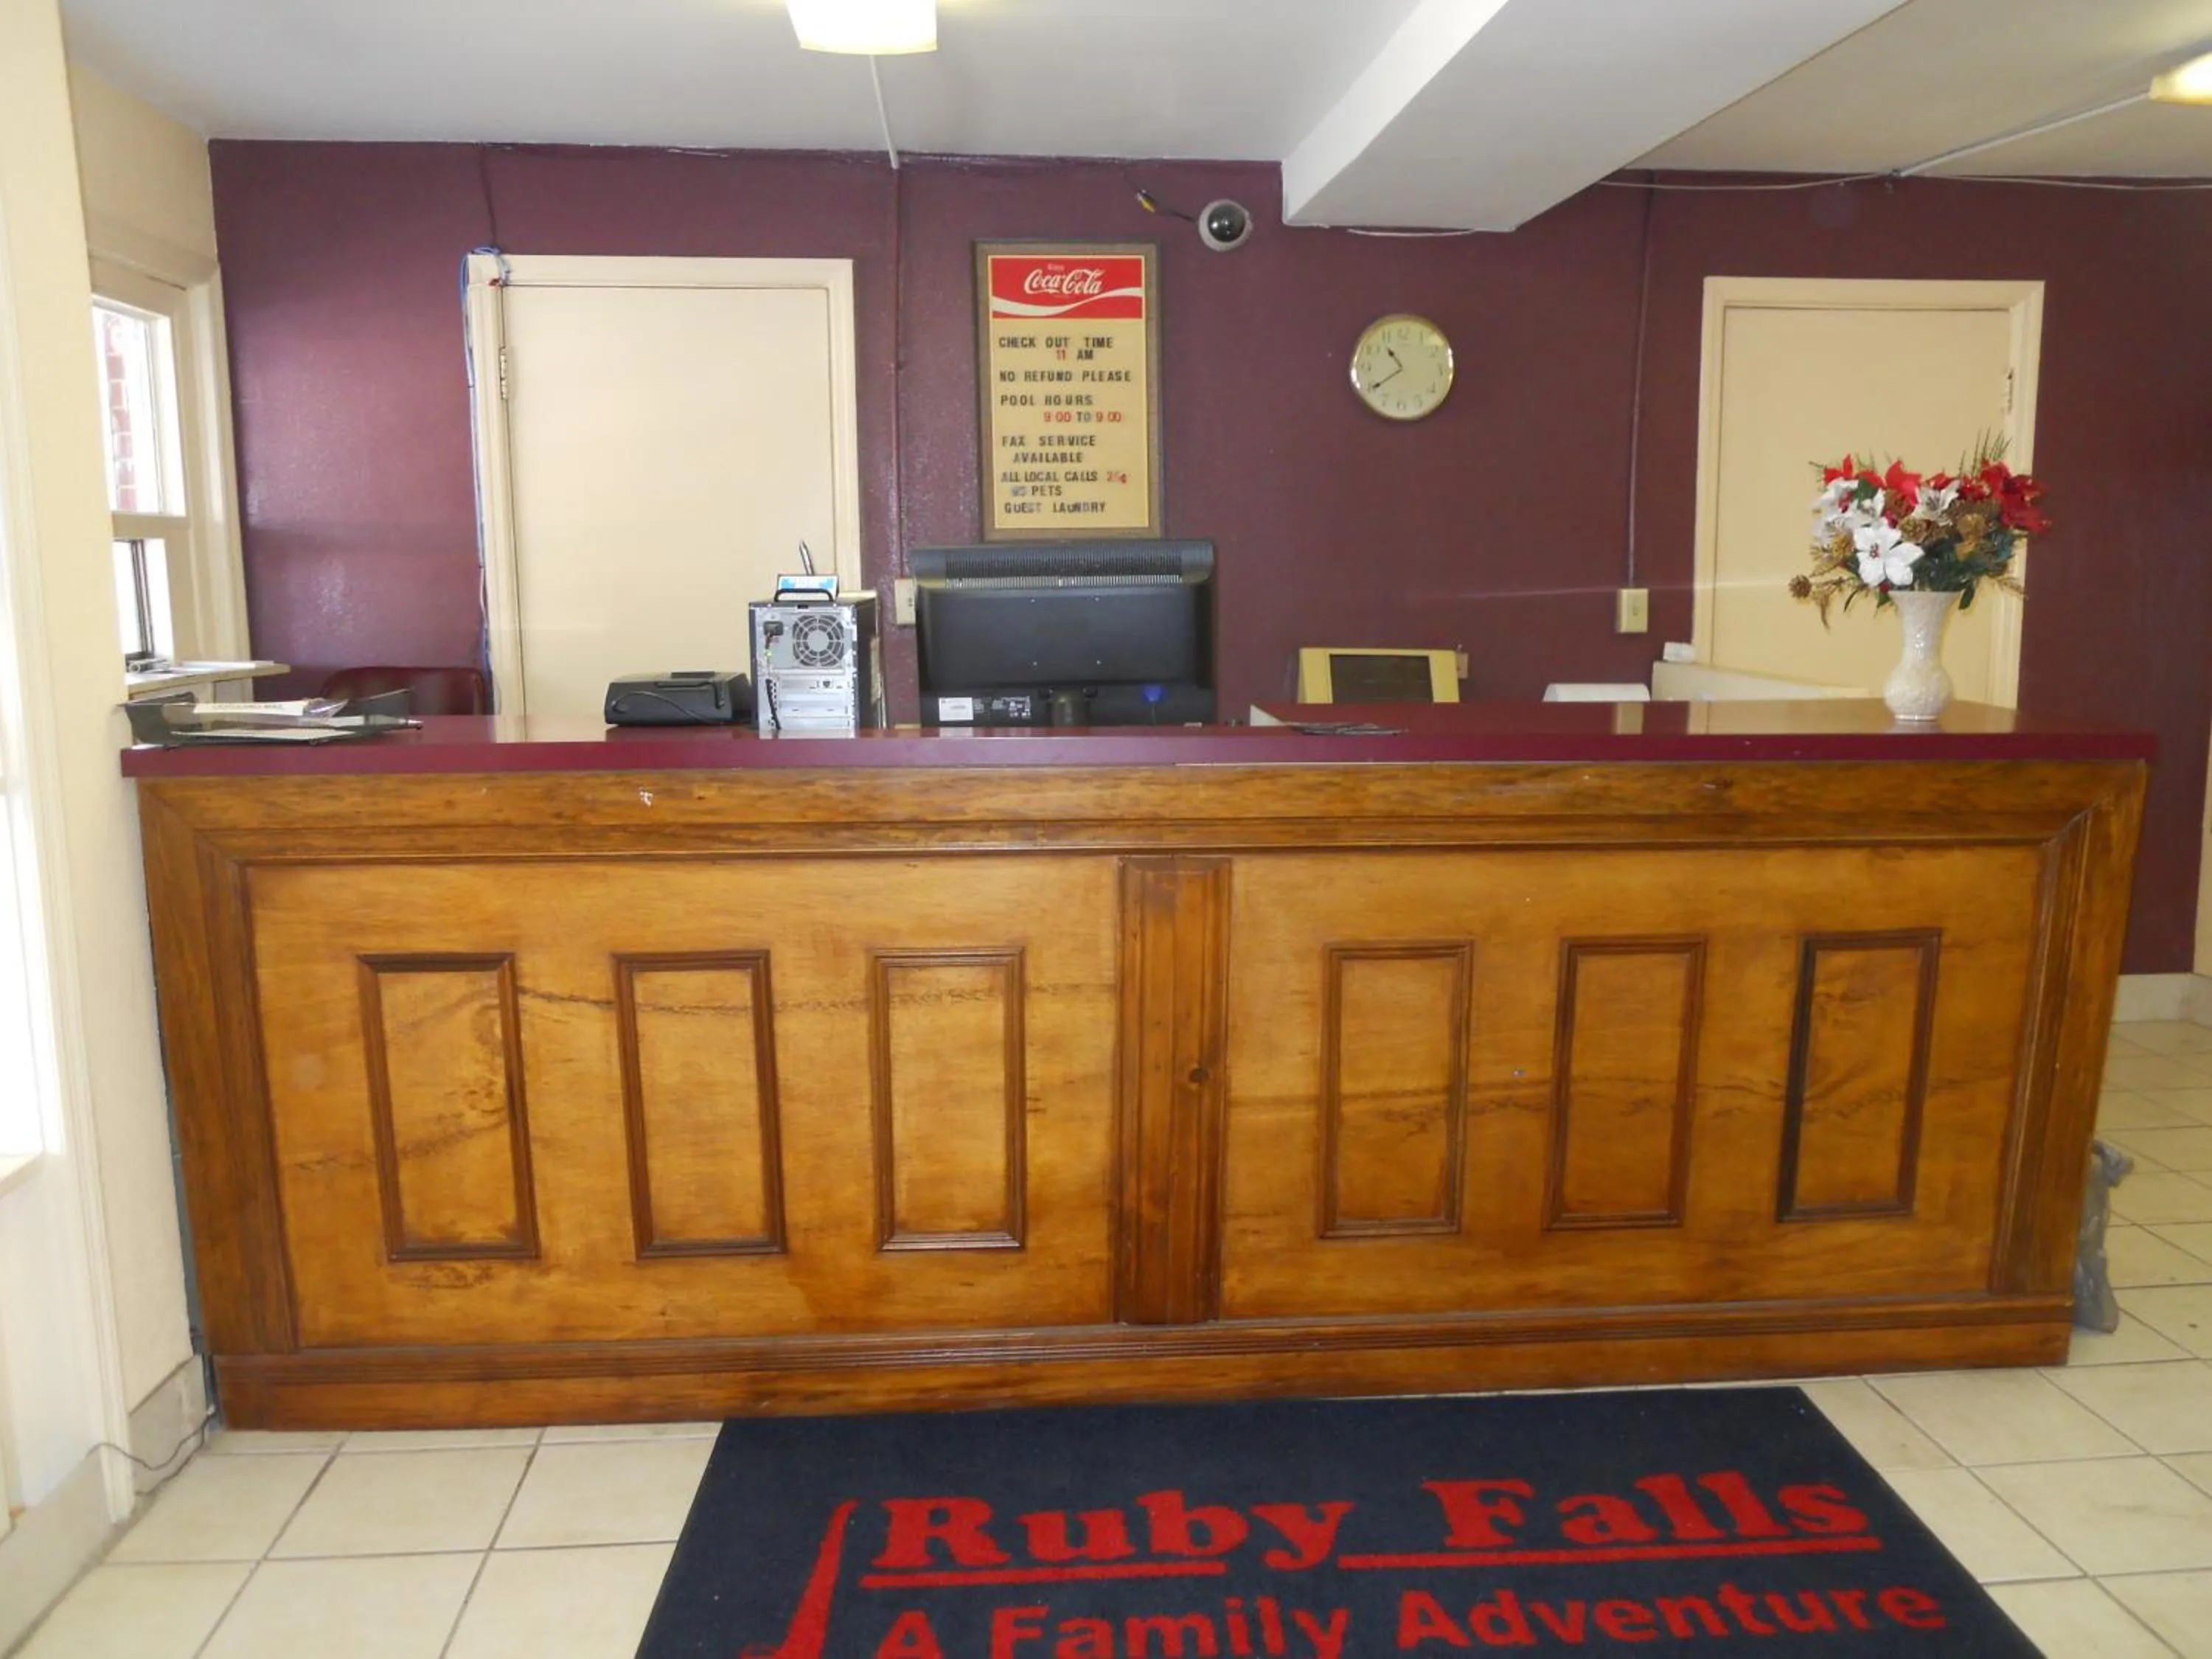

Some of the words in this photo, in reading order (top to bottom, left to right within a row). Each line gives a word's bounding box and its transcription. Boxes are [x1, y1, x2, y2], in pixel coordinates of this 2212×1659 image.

[1023, 268, 1105, 295] Coca-Cola
[998, 336, 1036, 349] CHECK
[1046, 336, 1069, 348] OUT
[1084, 336, 1113, 349] TIME
[1077, 349, 1093, 361] AM
[1000, 370, 1015, 382] NO
[1025, 370, 1072, 382] REFUND
[1082, 370, 1132, 383] PLEASE
[1001, 394, 1034, 406] POOL
[1044, 394, 1093, 406] HOURS
[1076, 411, 1091, 422] TO
[1001, 436, 1026, 447] FAX
[1039, 435, 1096, 447] SERVICE
[1013, 452, 1083, 464] AVAILABLE
[1001, 471, 1020, 483] ALL
[1024, 471, 1060, 483] LOCAL
[1064, 471, 1098, 482] CALLS
[1032, 485, 1062, 496] PETS
[1053, 502, 1106, 514] LAUNDRY
[872, 1490, 1354, 1571] Ruby
[1421, 1471, 1868, 1548] Falls
[990, 1596, 1351, 1659] Family
[1396, 1563, 1947, 1652] Adventure
